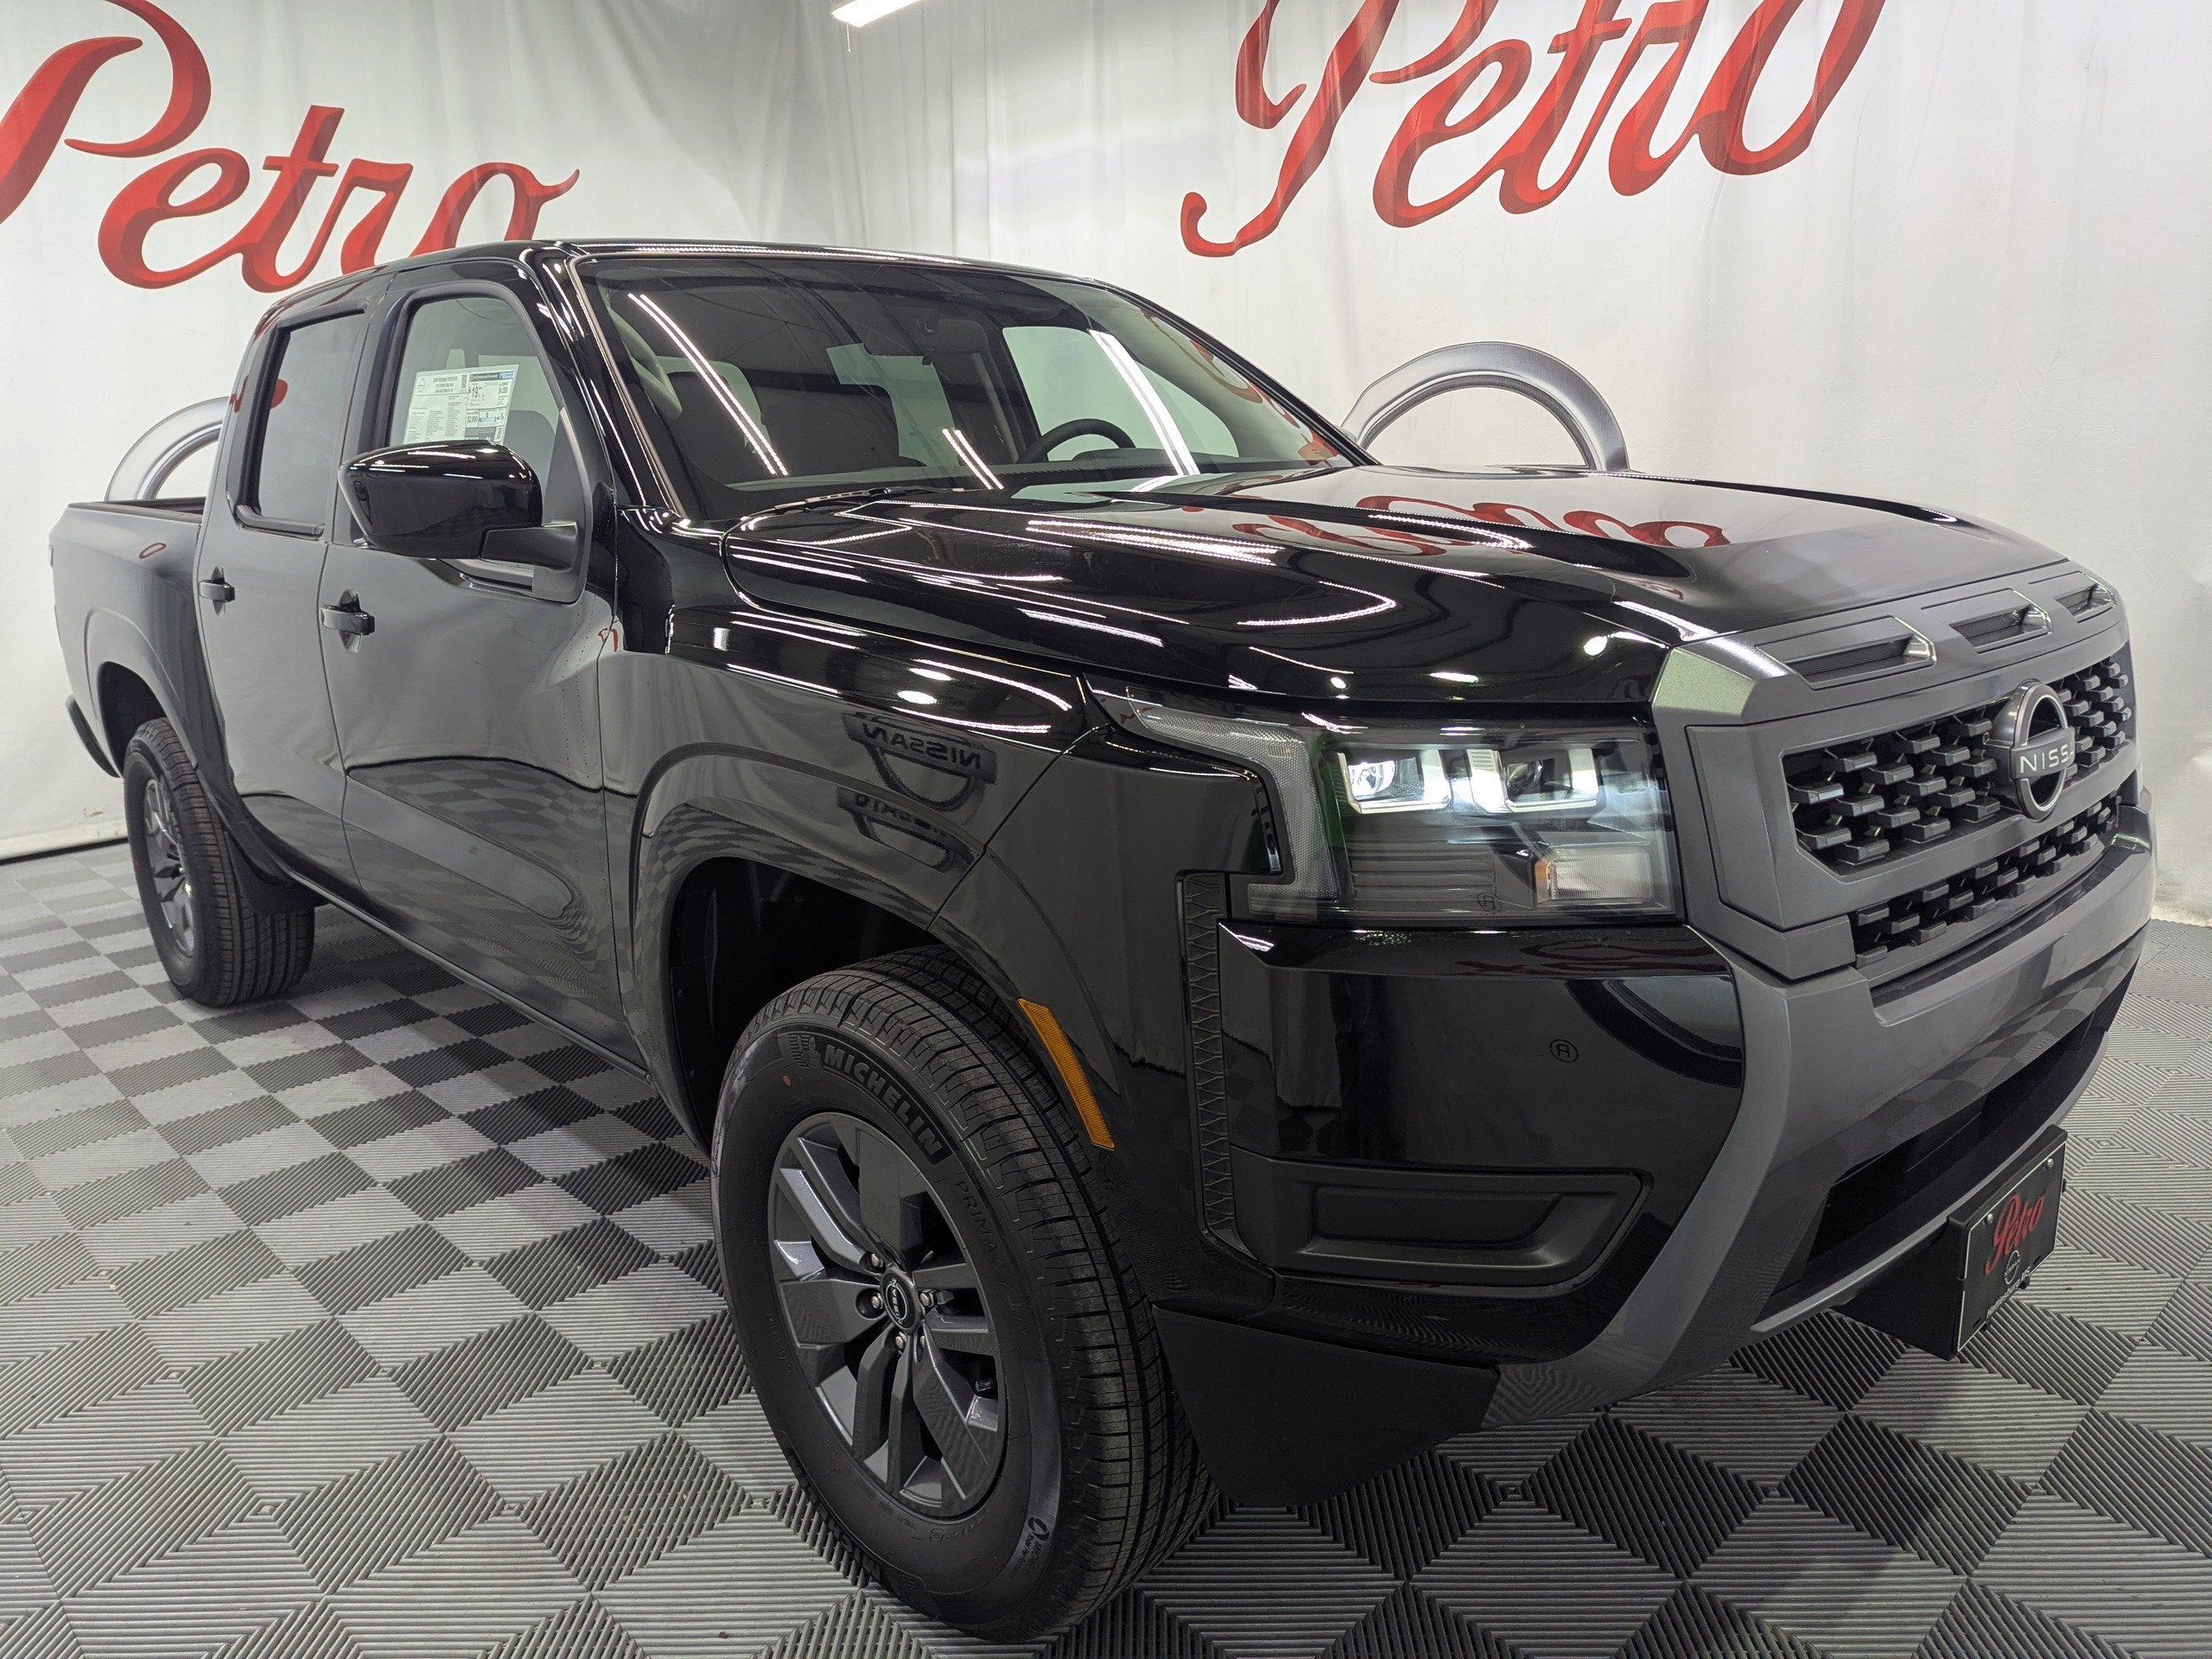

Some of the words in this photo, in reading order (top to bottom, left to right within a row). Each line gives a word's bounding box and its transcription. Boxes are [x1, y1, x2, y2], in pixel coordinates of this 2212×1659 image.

[0, 0, 580, 294] Petro
[1180, 0, 1889, 258] Petro
[824, 1044, 943, 1158] MICHELIN
